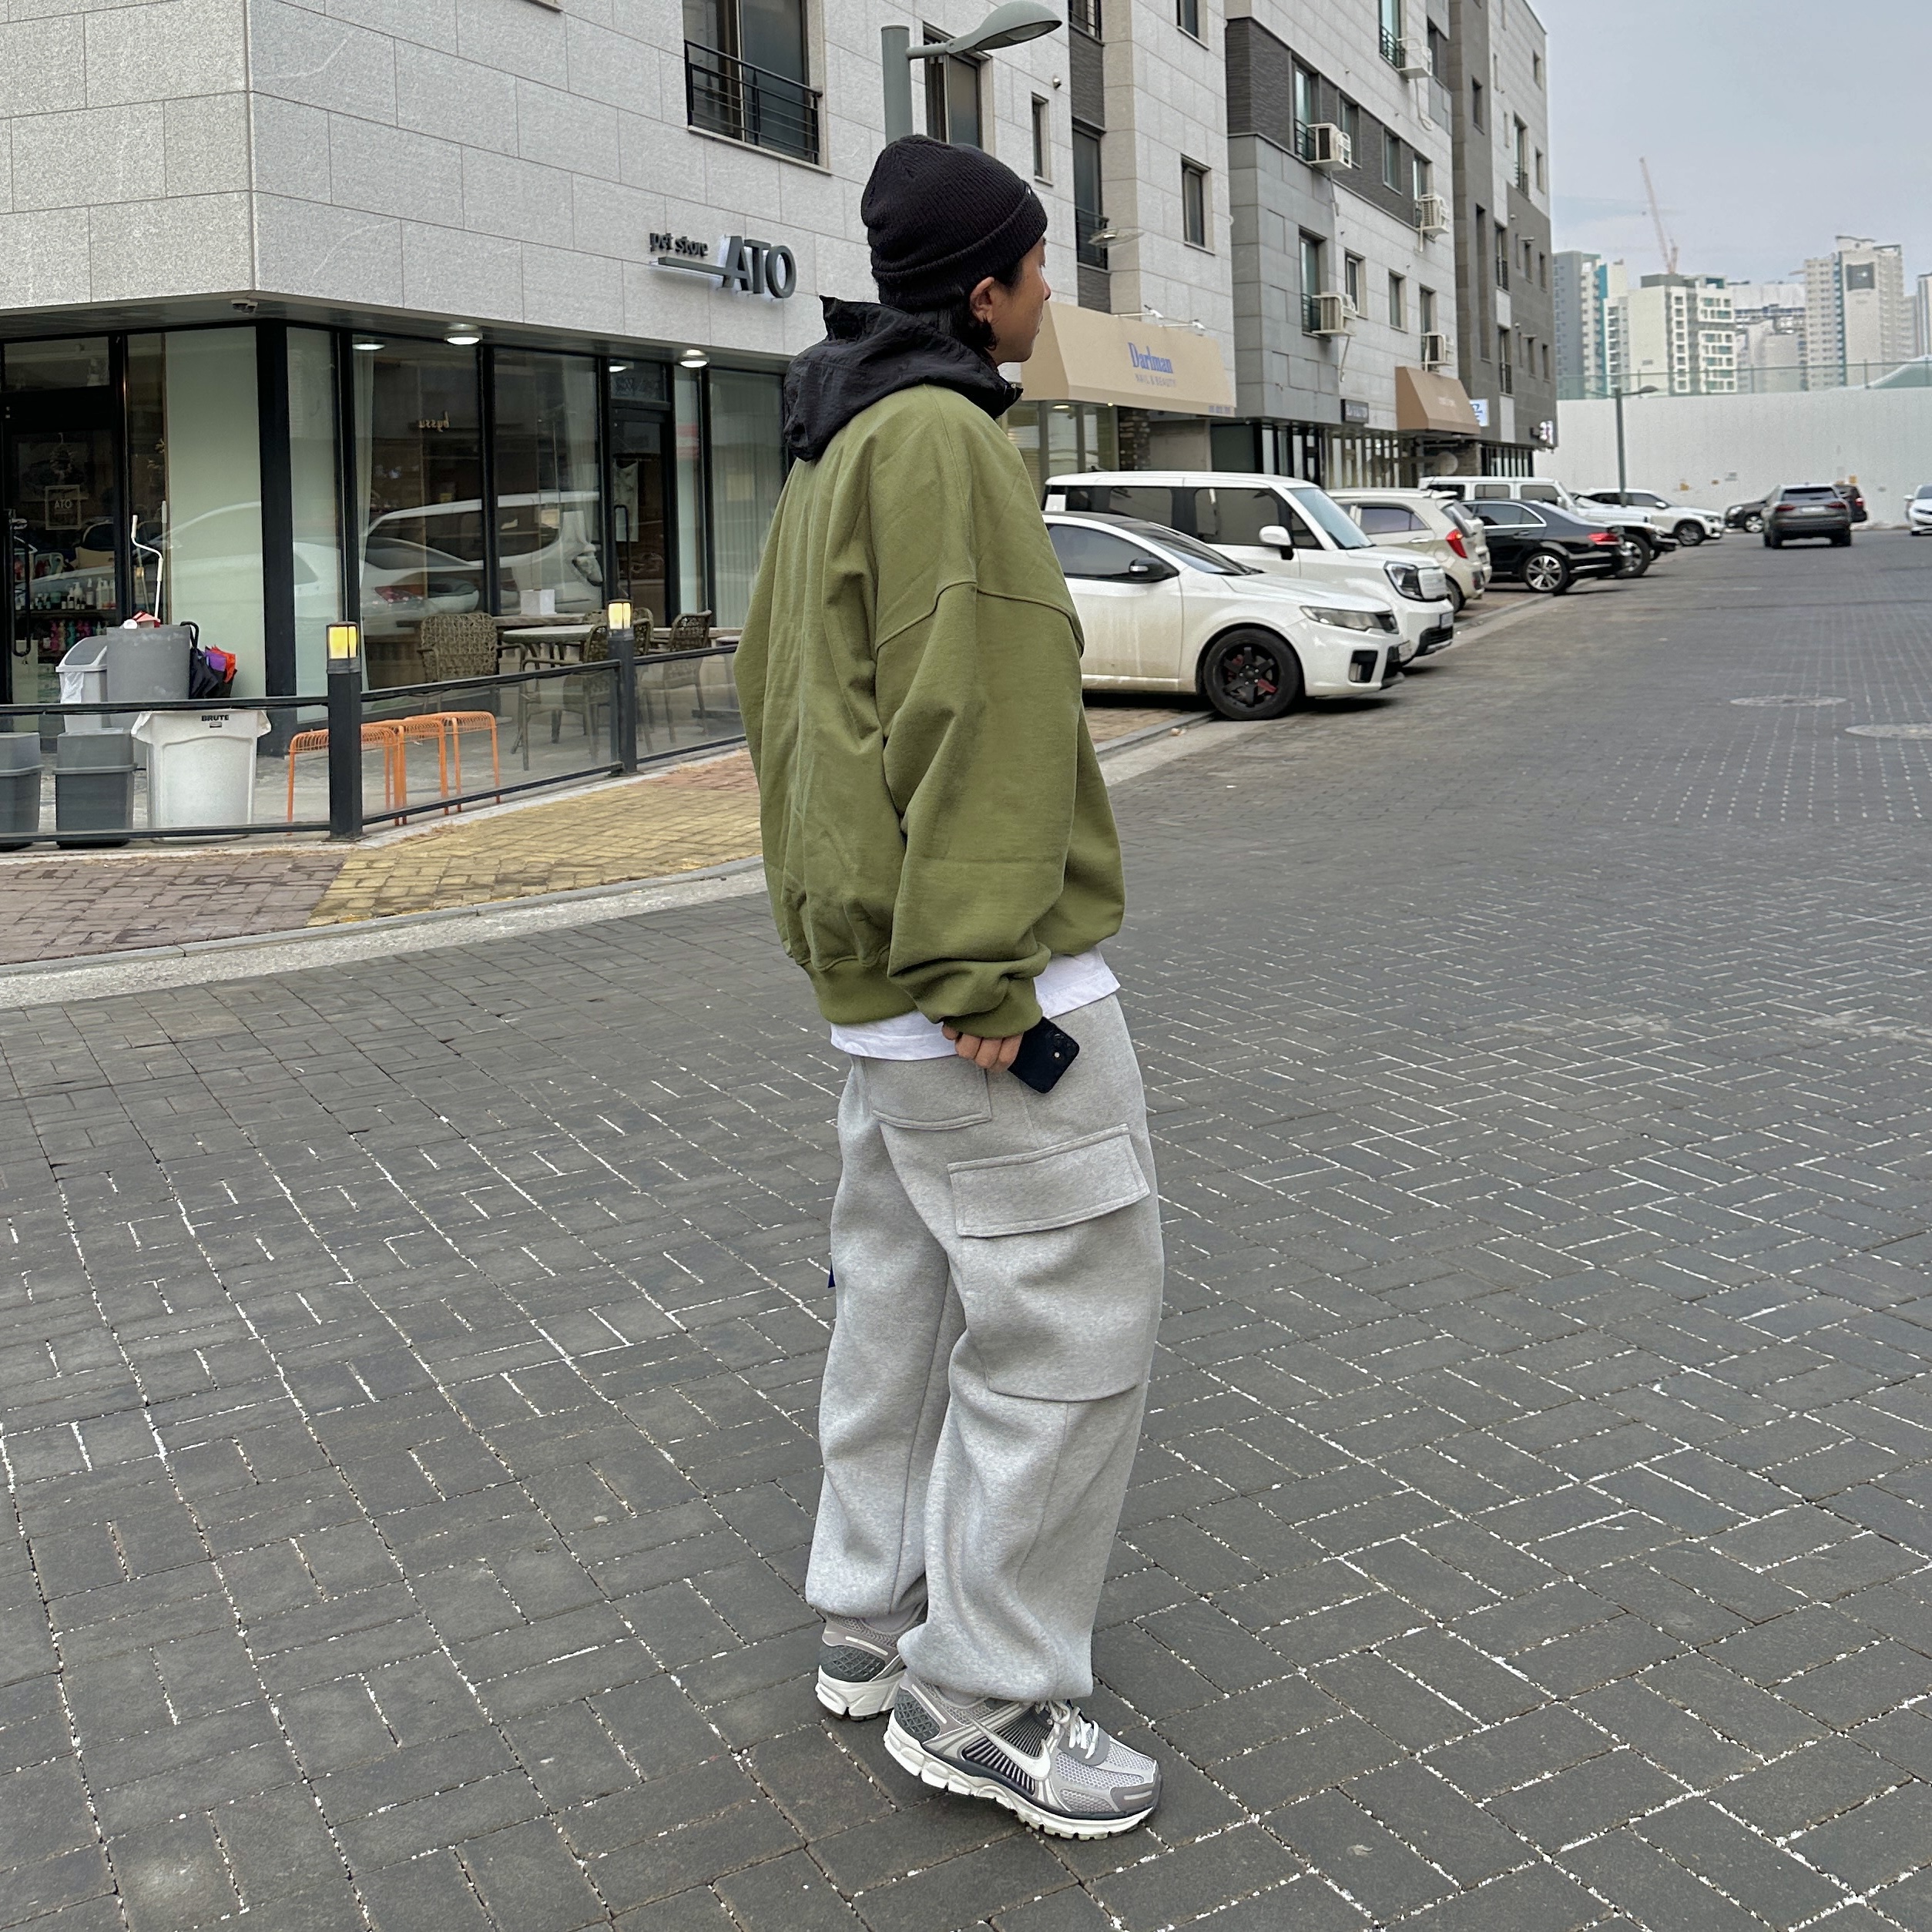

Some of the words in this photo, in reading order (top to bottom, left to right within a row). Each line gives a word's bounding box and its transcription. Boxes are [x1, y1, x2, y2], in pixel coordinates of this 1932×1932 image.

[649, 233, 673, 252] pet
[675, 236, 708, 257] store
[722, 236, 797, 298] ATO
